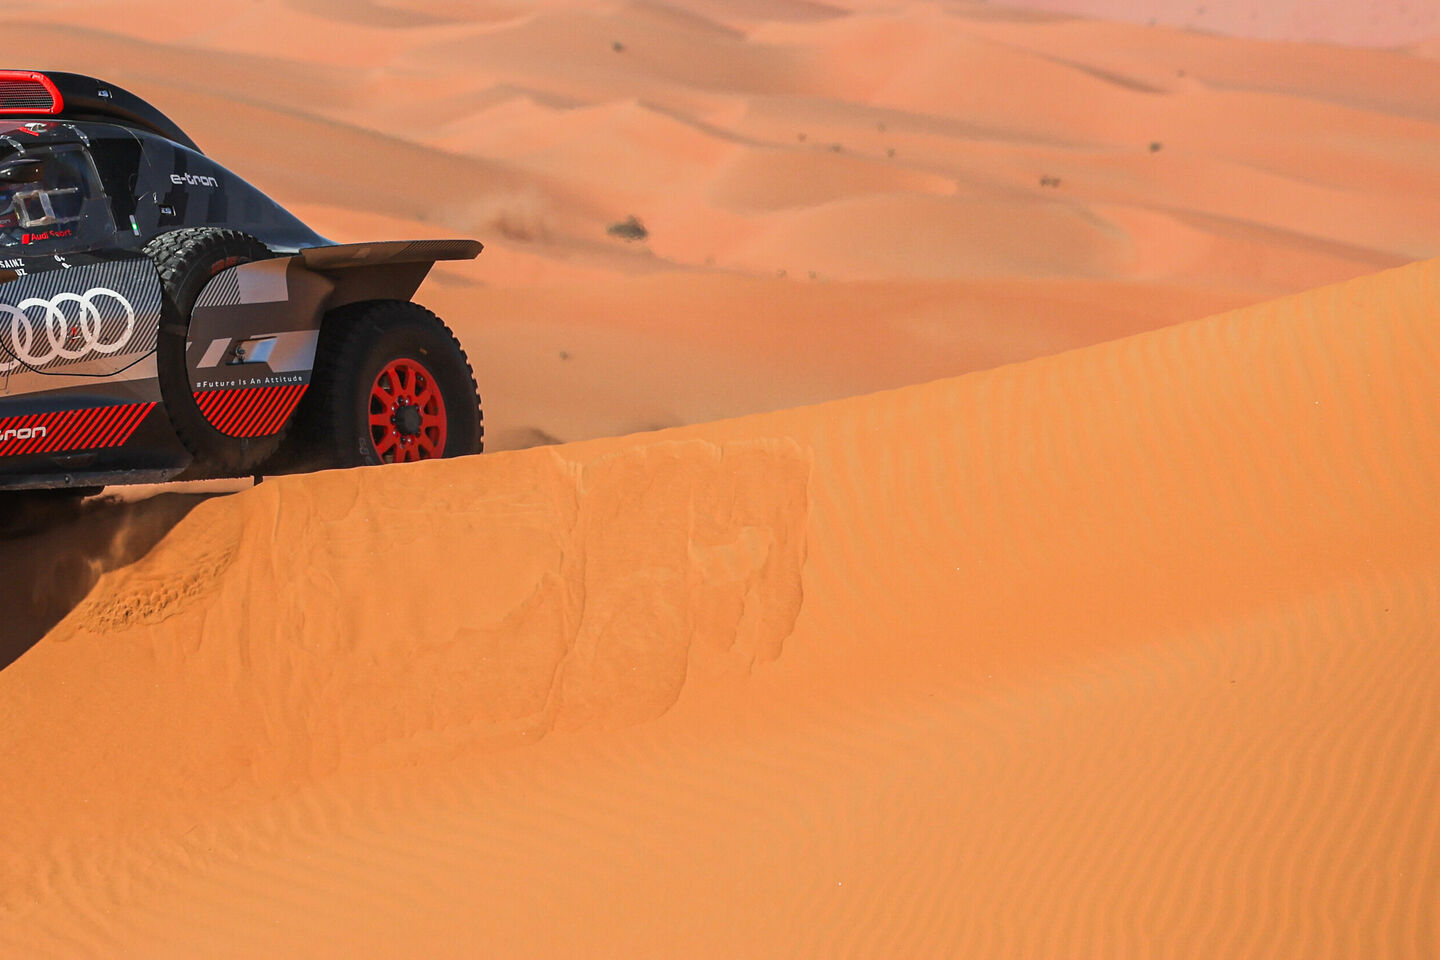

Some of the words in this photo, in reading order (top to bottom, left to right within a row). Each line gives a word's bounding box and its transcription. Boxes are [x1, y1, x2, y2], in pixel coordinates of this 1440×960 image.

[169, 172, 219, 188] e-tron
[31, 233, 49, 241] Audi
[196, 380, 235, 388] #Future
[265, 375, 303, 384] Attitude
